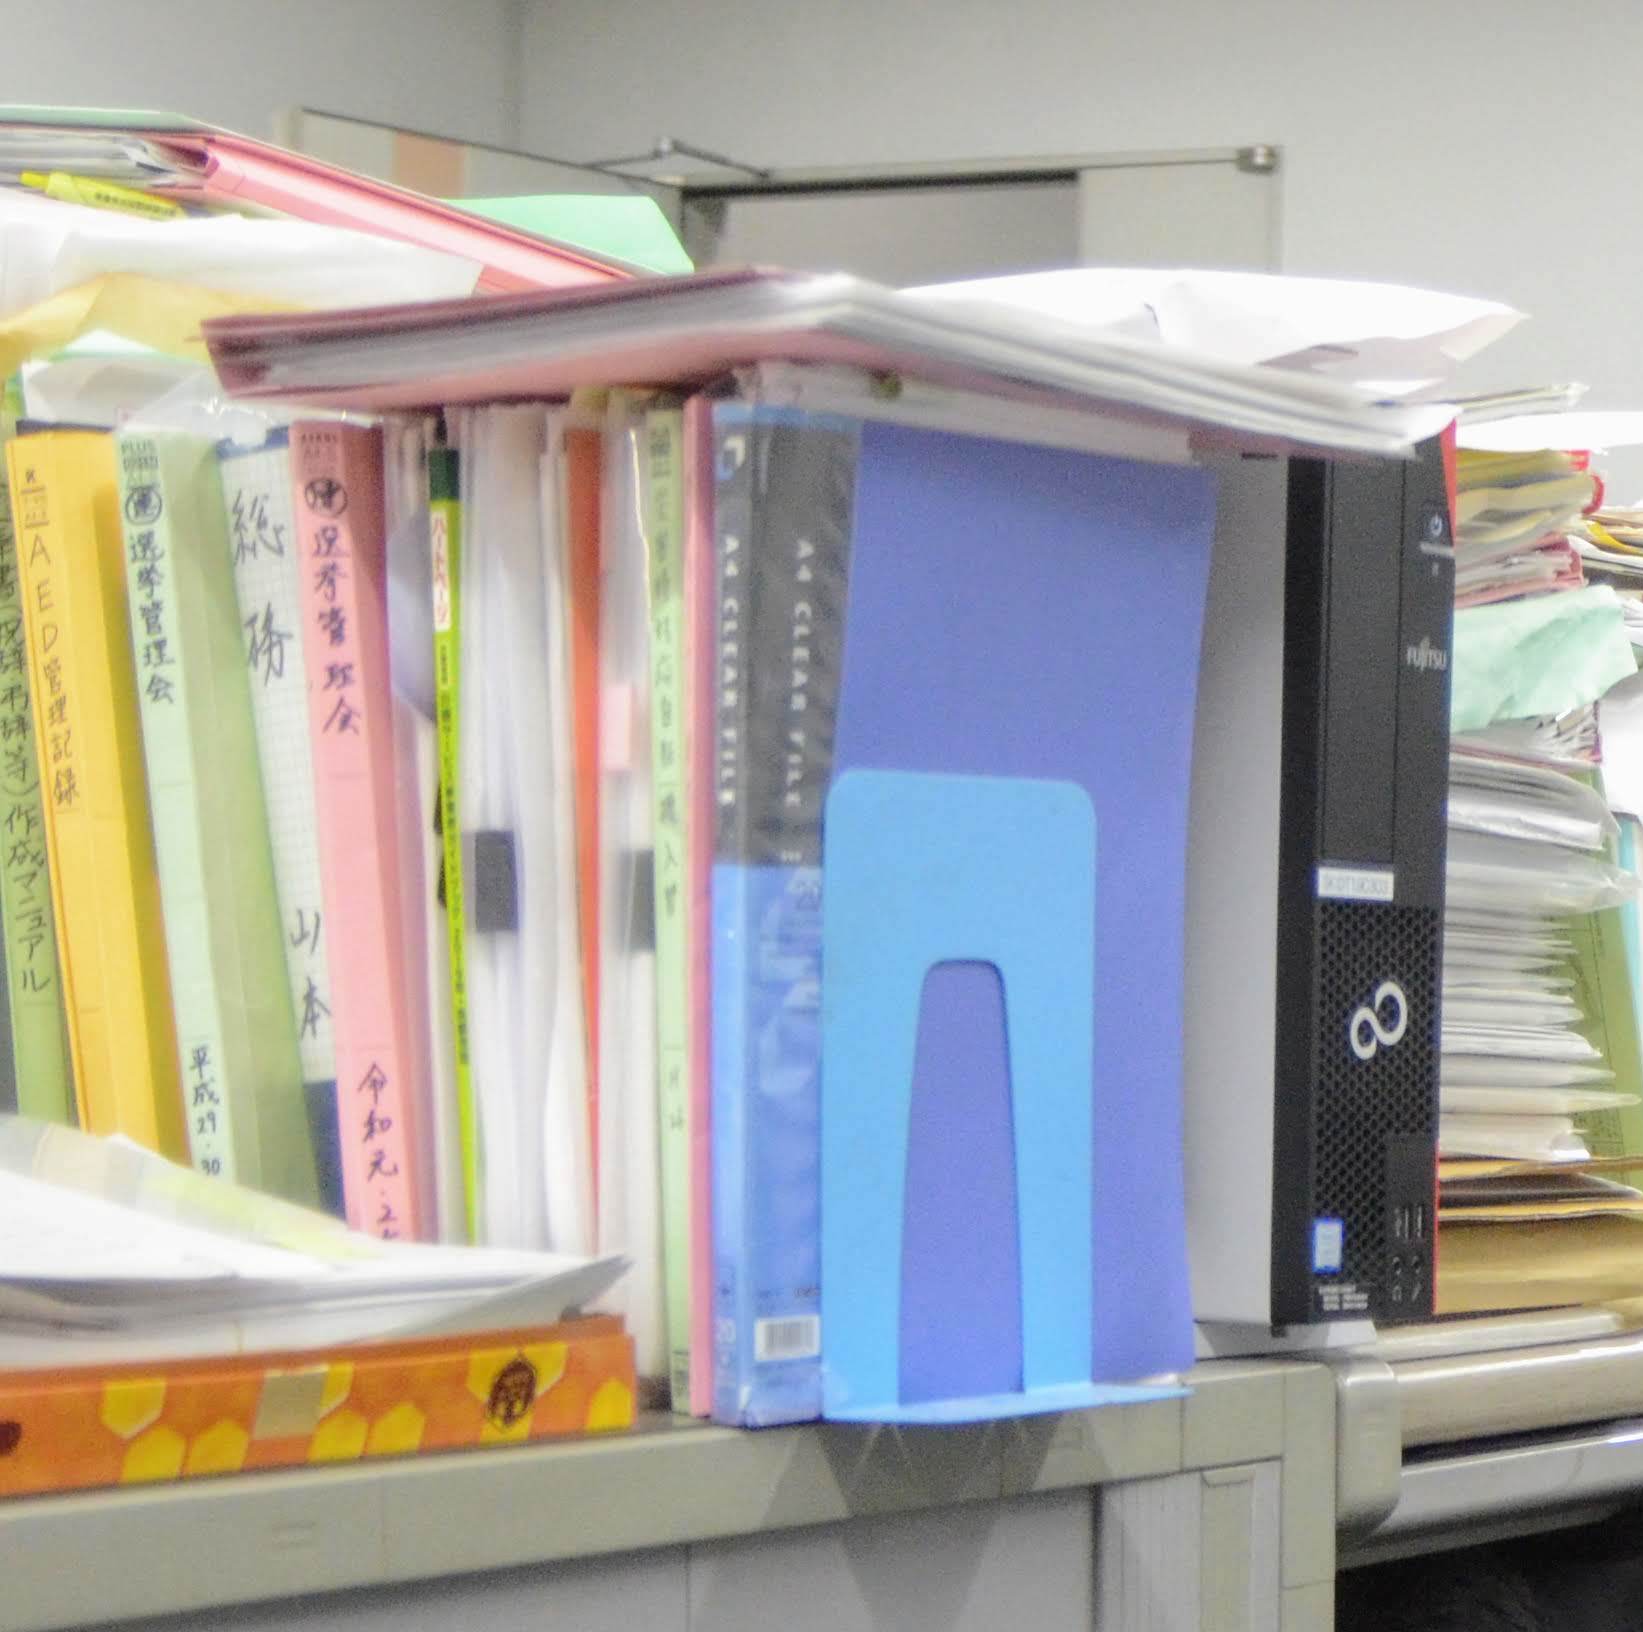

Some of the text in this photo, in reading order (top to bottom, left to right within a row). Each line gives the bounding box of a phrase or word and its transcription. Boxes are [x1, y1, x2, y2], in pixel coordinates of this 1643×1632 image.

[722, 597, 739, 708] CLEAR
[790, 601, 812, 712] CLEAR
[718, 729, 737, 803] FILE
